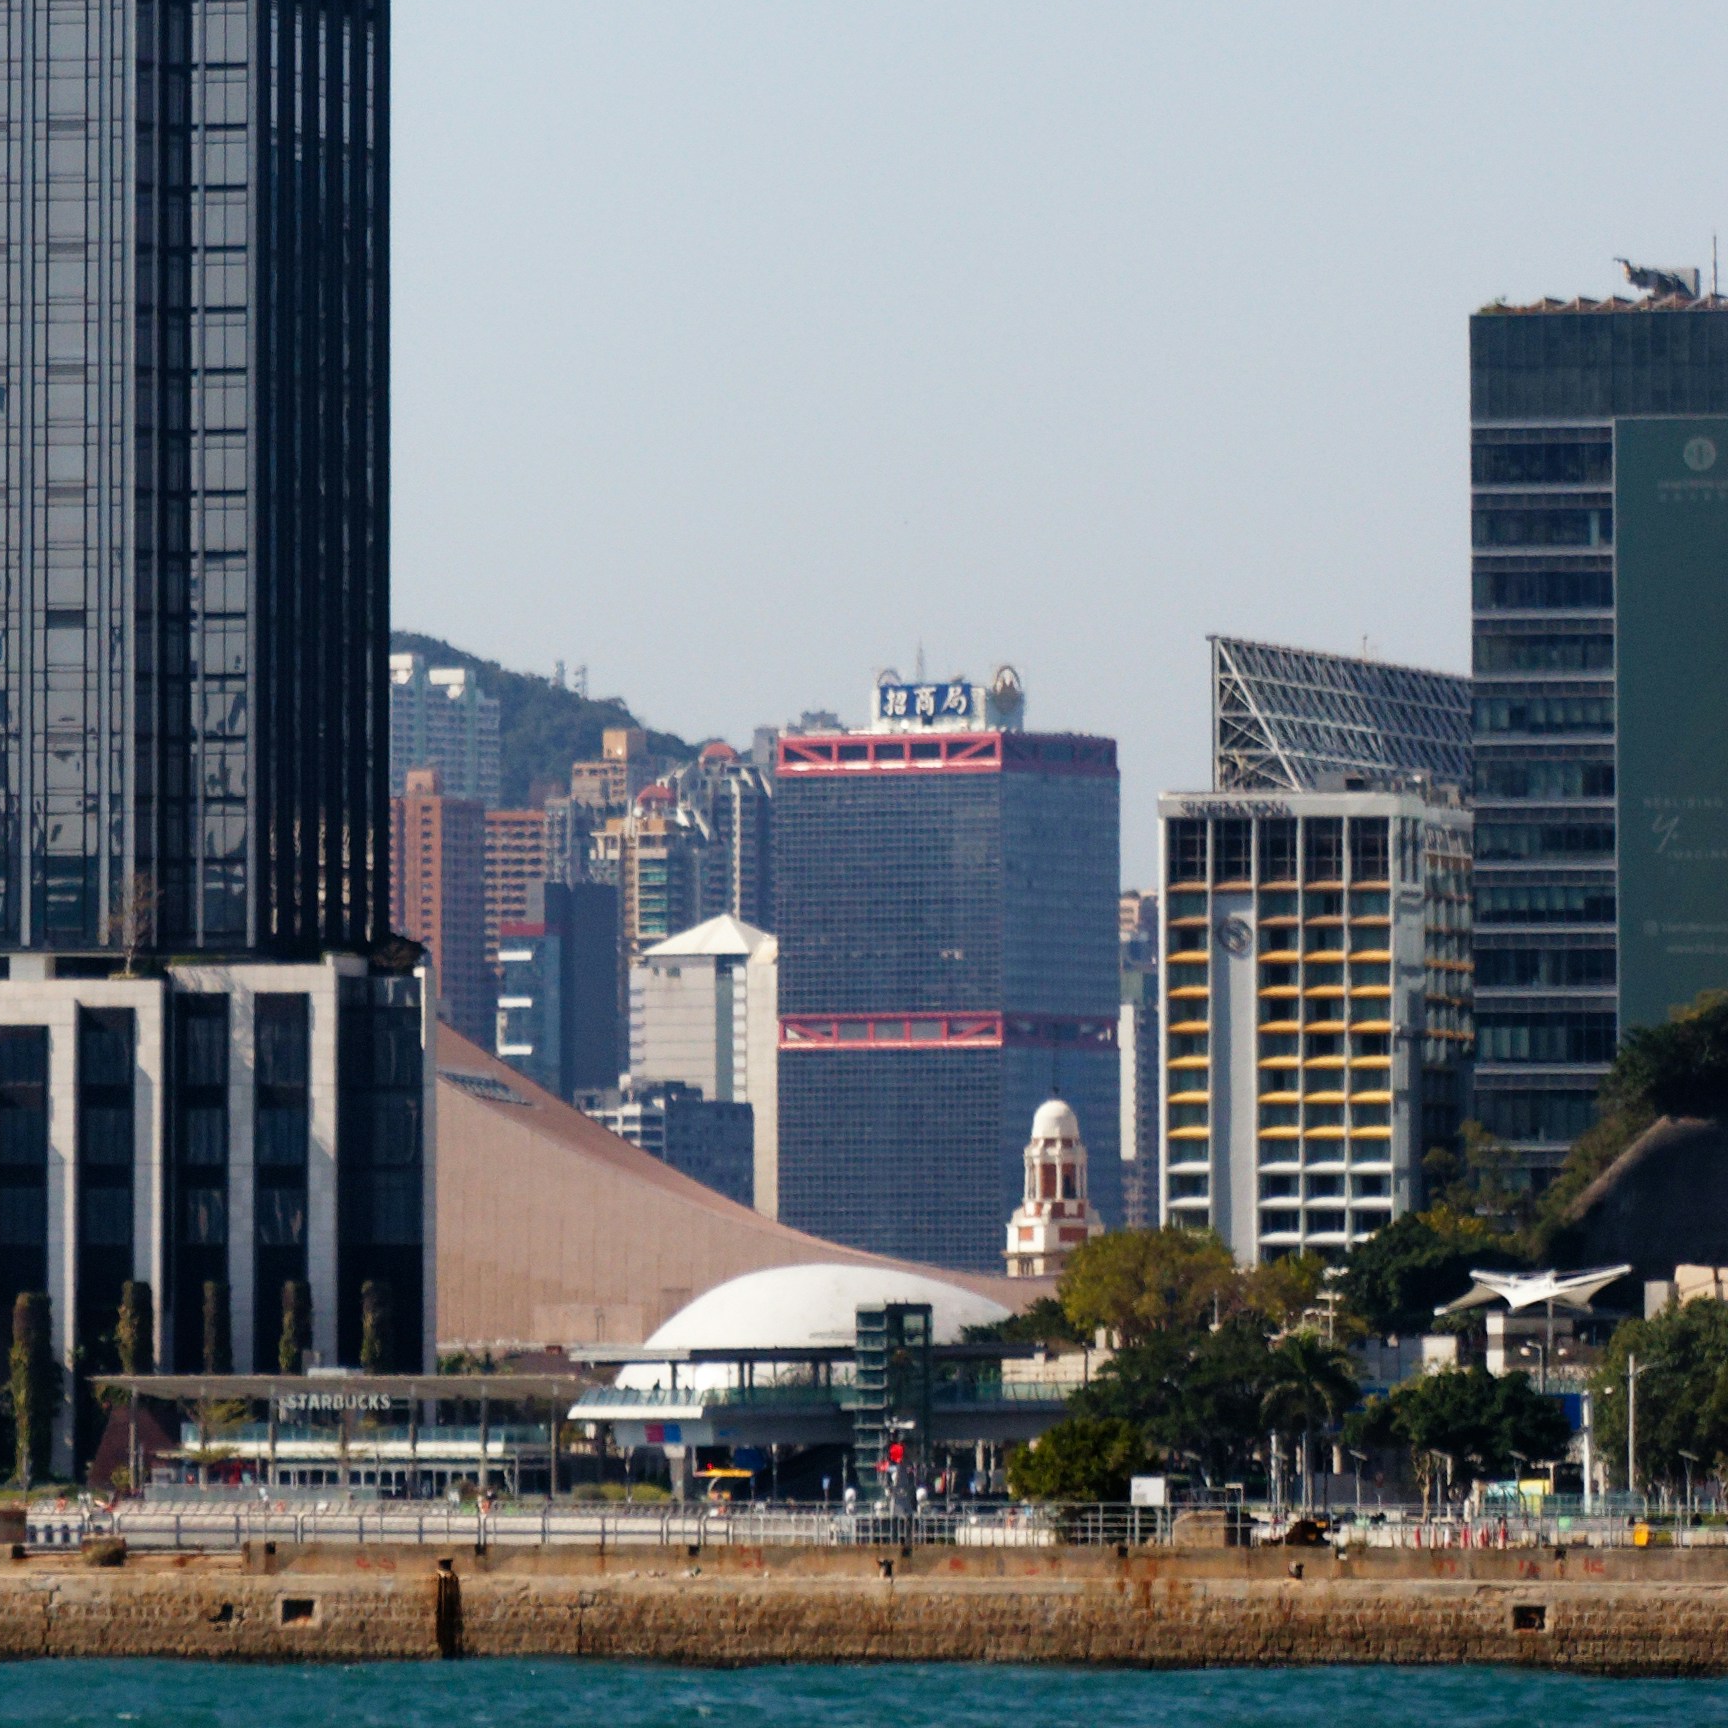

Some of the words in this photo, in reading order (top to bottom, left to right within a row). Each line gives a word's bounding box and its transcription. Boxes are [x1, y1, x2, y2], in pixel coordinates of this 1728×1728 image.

[883, 686, 967, 716] 招商局
[286, 1393, 391, 1411] STARBUCKS
